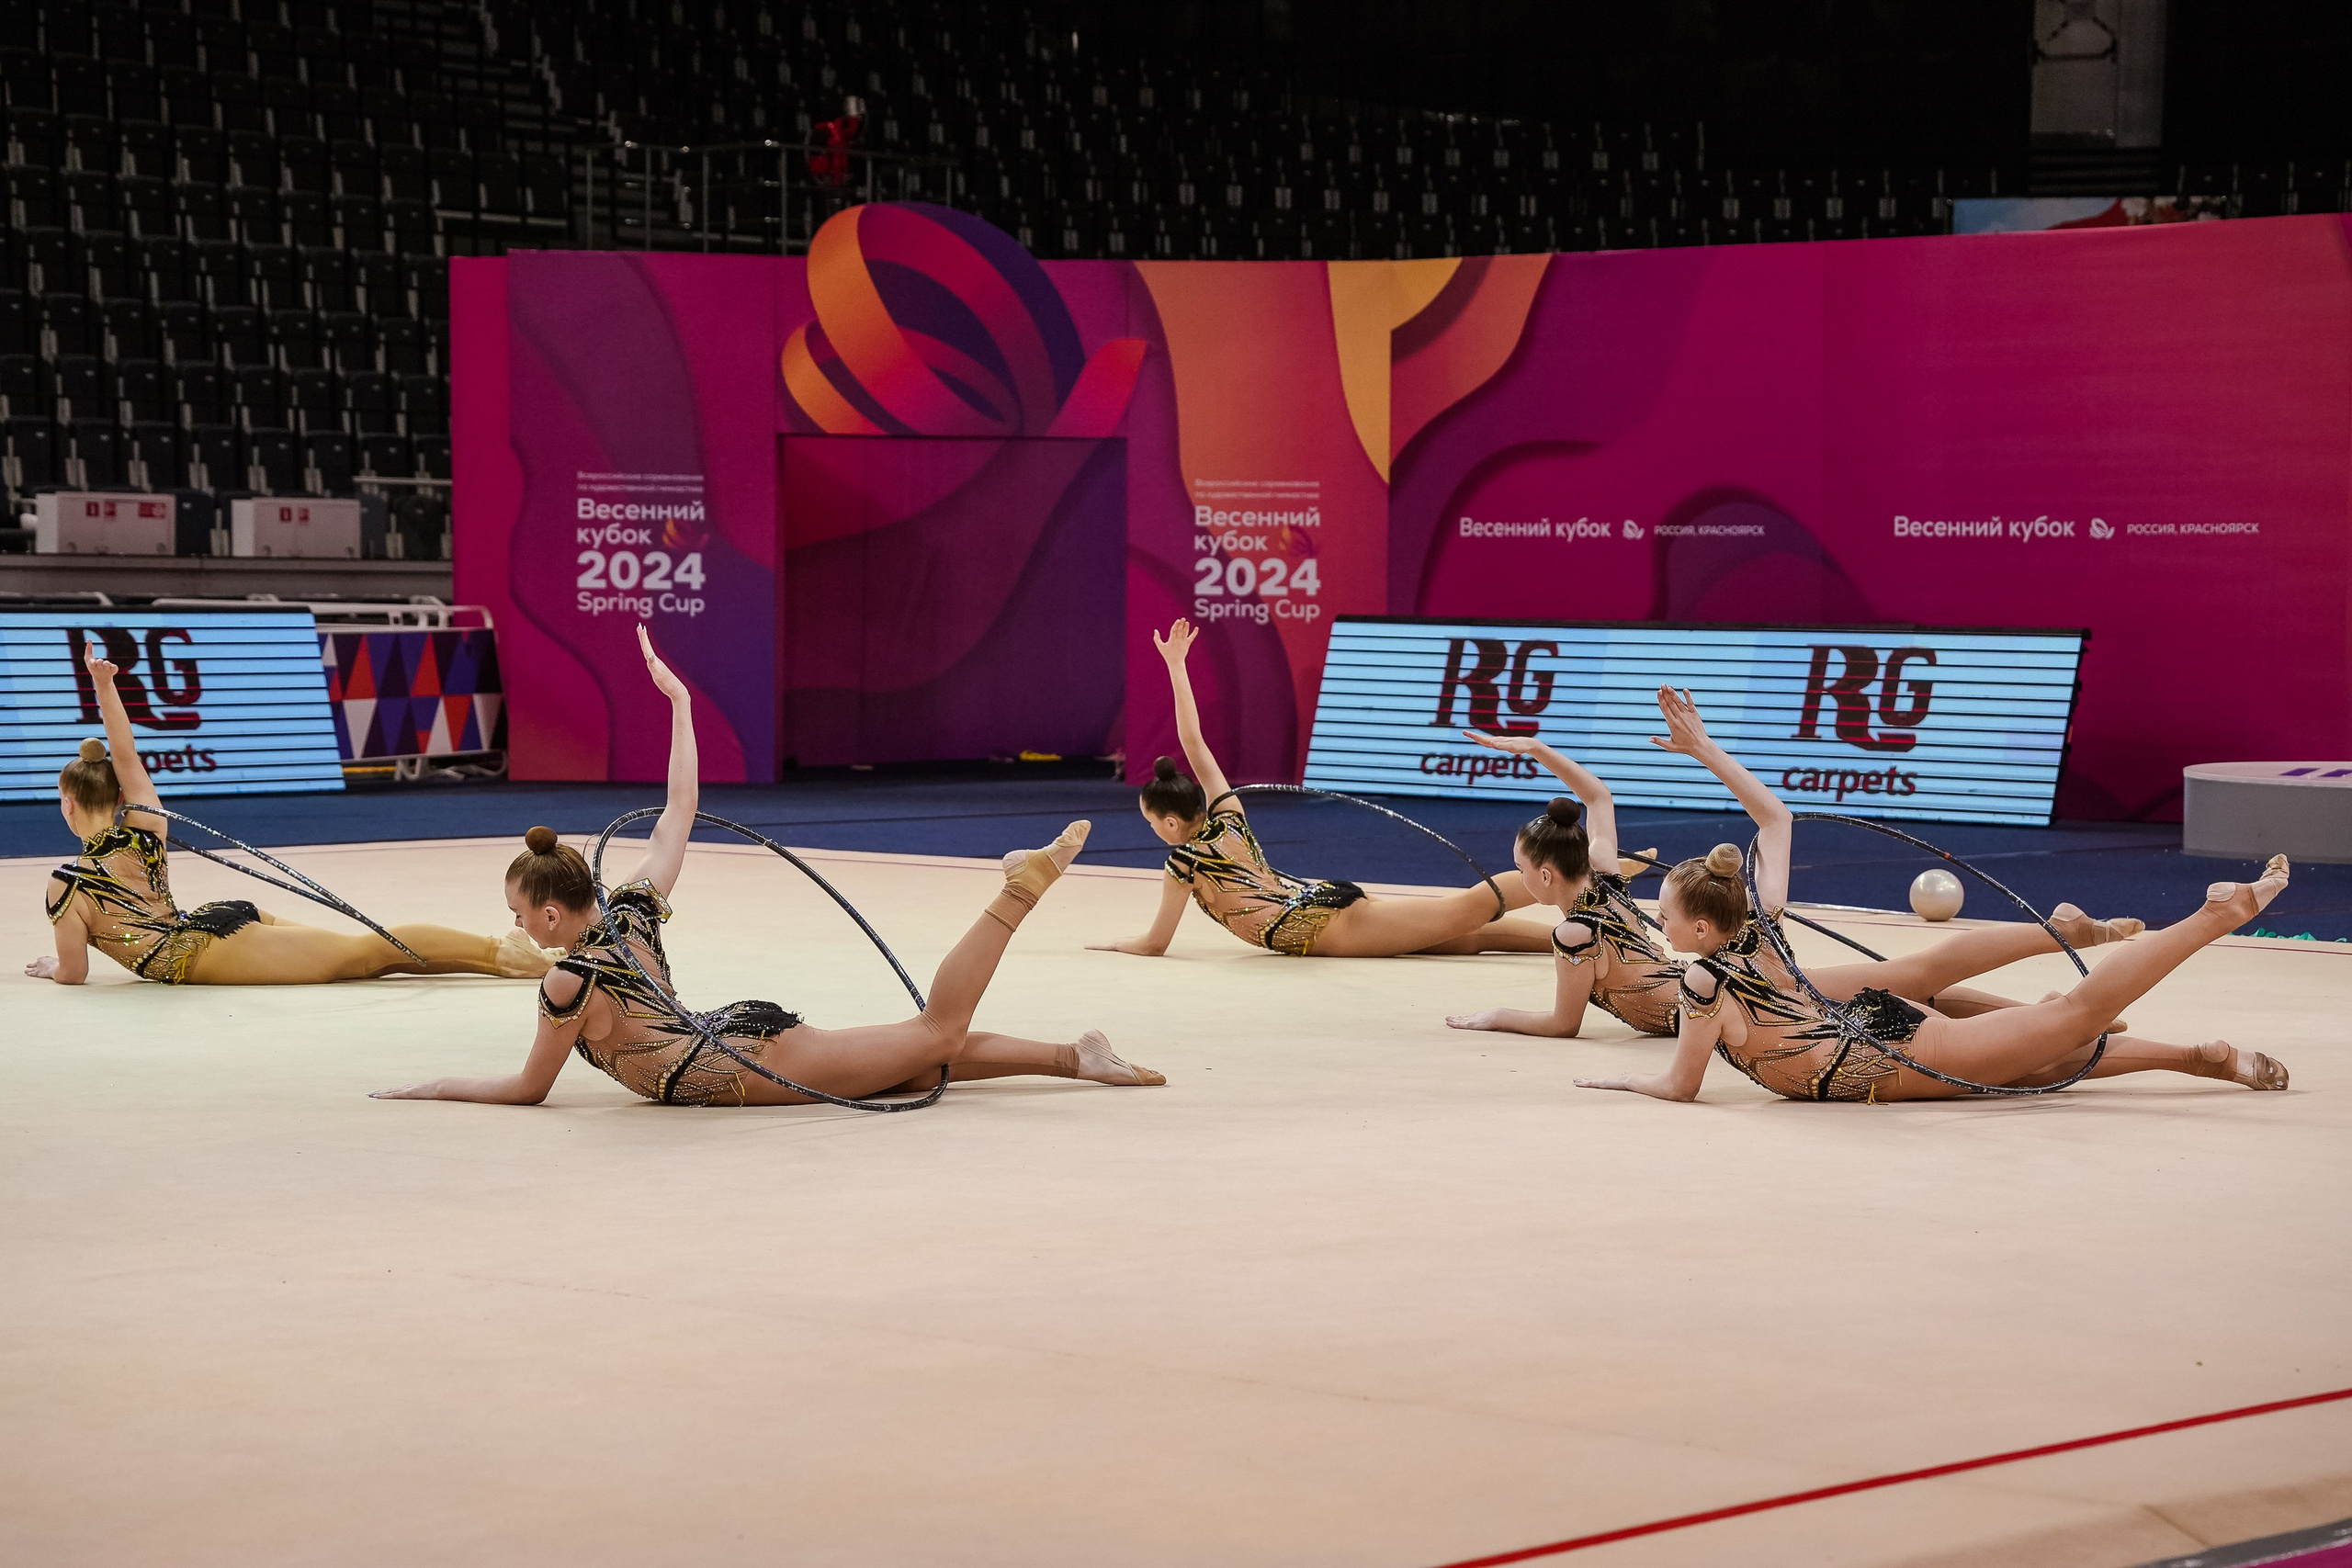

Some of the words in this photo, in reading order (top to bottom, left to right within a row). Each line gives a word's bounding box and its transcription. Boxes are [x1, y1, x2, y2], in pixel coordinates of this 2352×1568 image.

[577, 497, 706, 521] Весенний
[1194, 505, 1321, 527] Весенний
[577, 523, 652, 549] кубок
[1459, 516, 1551, 537] Весенний
[1555, 516, 1611, 543] кубок
[1894, 515, 2003, 537] Весенний
[2008, 515, 2075, 543] кубок
[2179, 523, 2259, 534] КРАСНОЯРСК
[1194, 530, 1268, 557] кубок
[577, 550, 706, 590] 2024
[1194, 557, 1321, 596] 2024
[577, 592, 653, 618] Spring
[659, 592, 706, 617] Cup
[1194, 598, 1270, 625] Spring
[1275, 599, 1320, 624] Cup
[64, 627, 202, 730] RG
[1430, 637, 1558, 738] RG
[1791, 644, 1937, 752] RG
[1420, 753, 1538, 785] carpets
[1781, 766, 1918, 802] carpets
